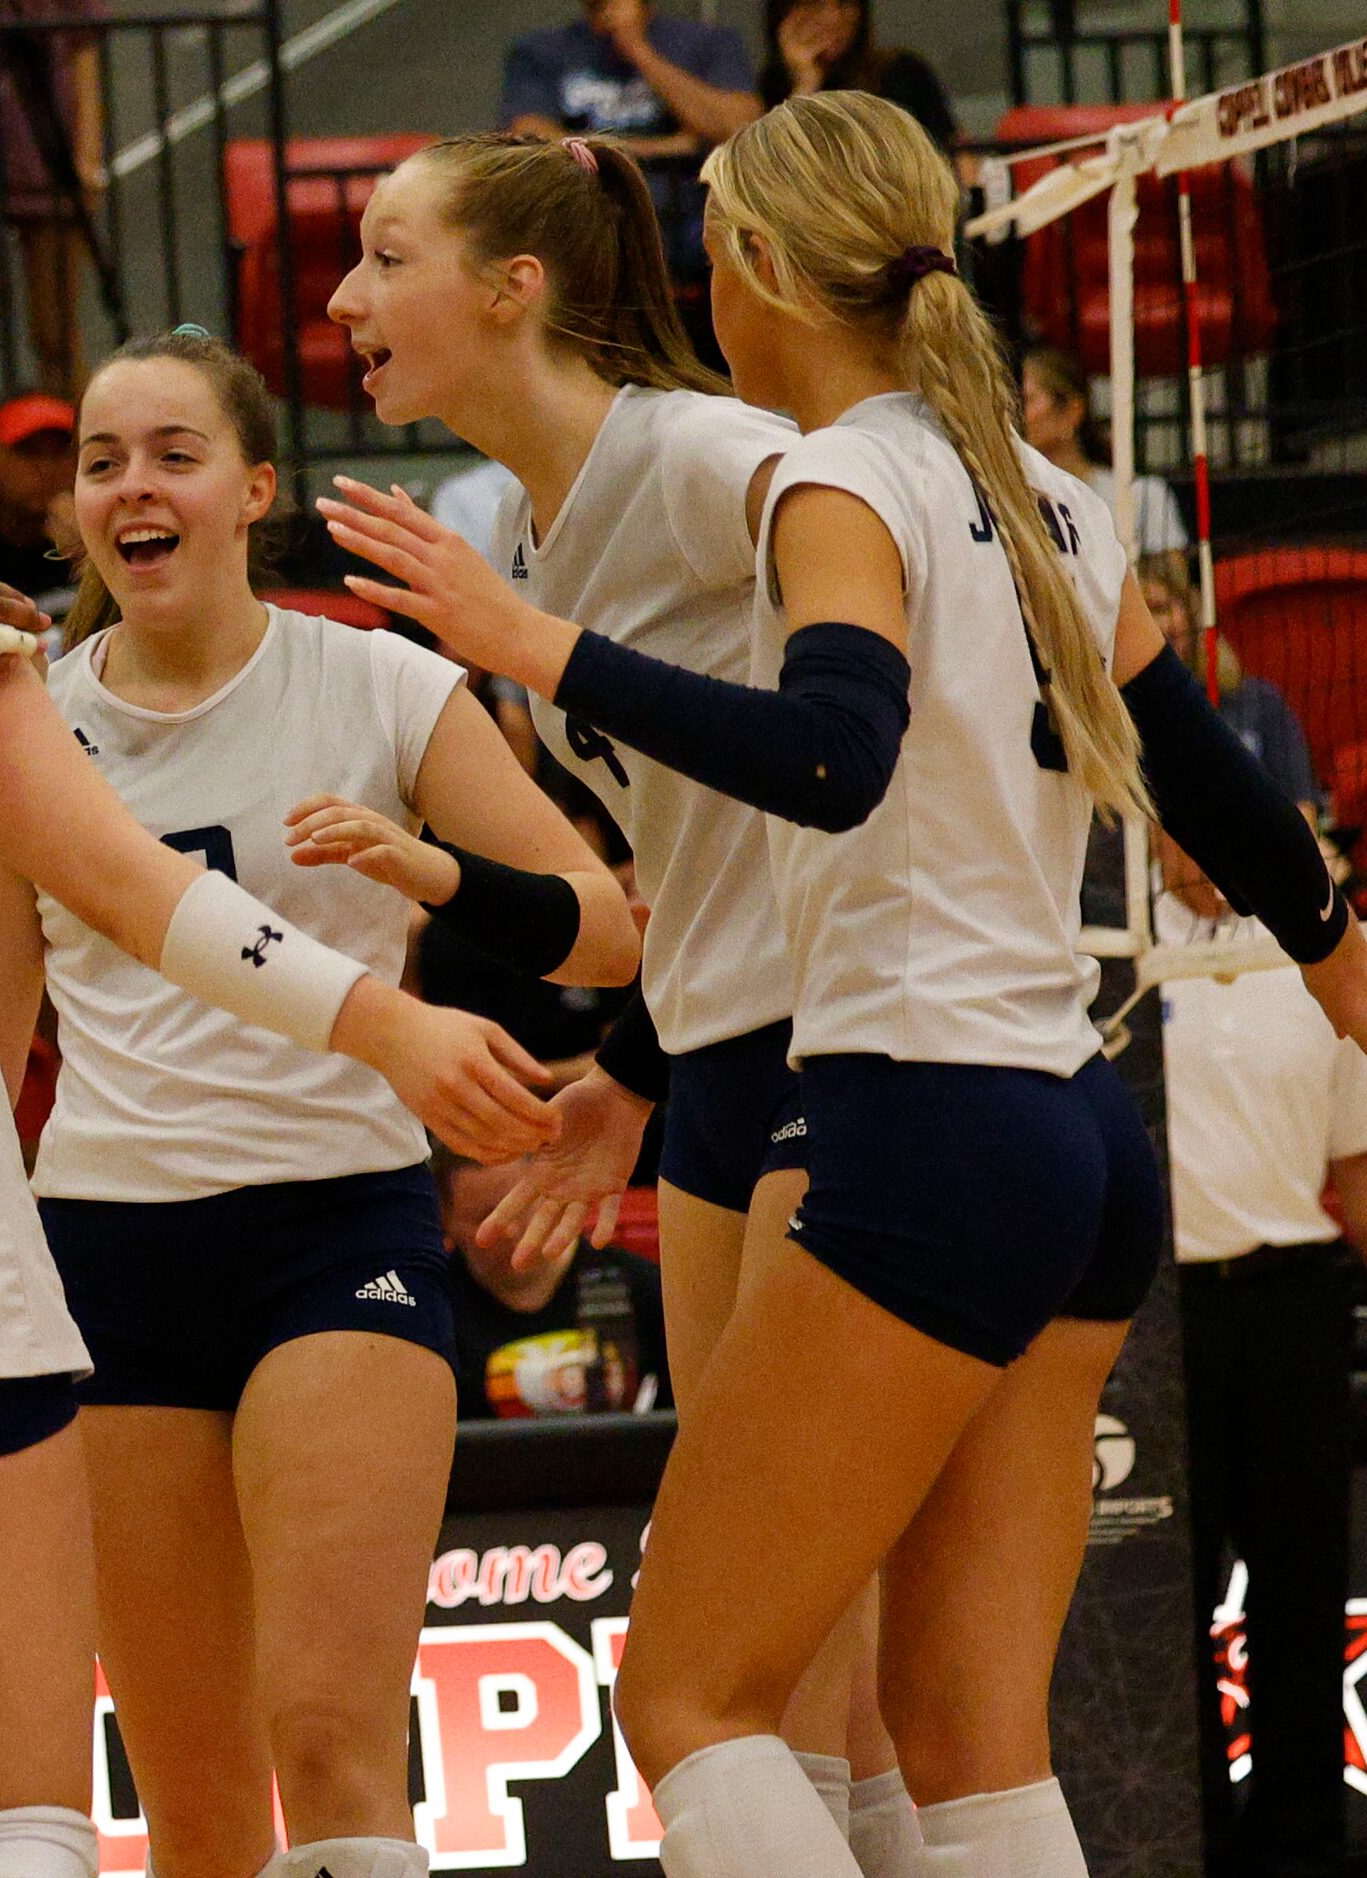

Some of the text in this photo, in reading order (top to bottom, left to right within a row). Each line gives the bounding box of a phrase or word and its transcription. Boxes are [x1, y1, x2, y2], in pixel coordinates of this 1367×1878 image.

[771, 1121, 808, 1143] adida
[355, 1288, 417, 1307] adidas
[426, 1541, 614, 1608] ome
